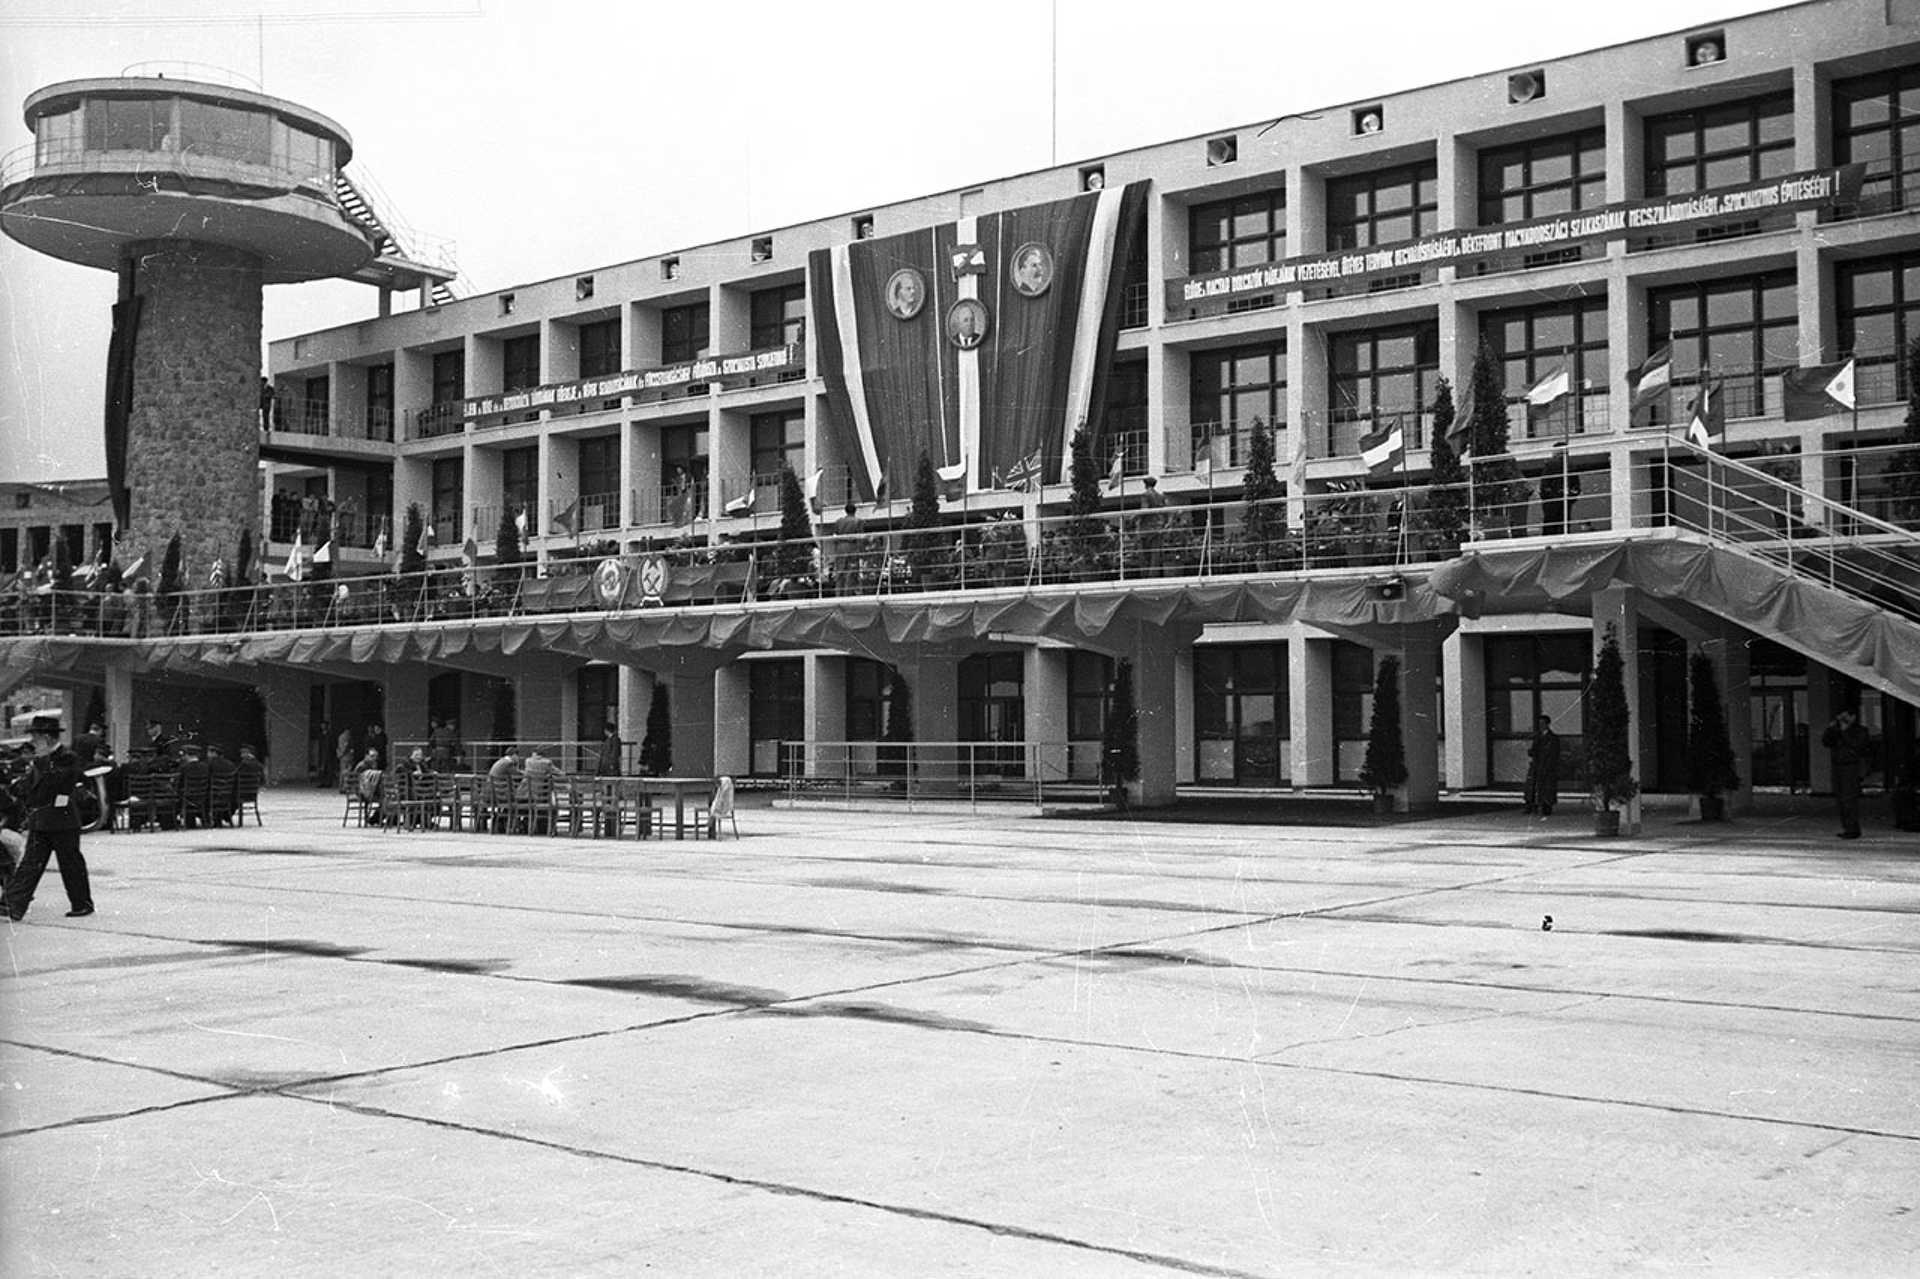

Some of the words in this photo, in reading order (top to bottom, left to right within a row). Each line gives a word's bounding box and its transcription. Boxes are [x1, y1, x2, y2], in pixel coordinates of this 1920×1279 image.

[1206, 277, 1230, 296] MAGYAR
[1461, 233, 1503, 255] BÉKEFRONT
[1505, 219, 1569, 249] MAGYARORSZÁGI
[1570, 210, 1626, 238] SZAKASZÁNAK
[1723, 185, 1779, 213] SZOCIALIZMUS
